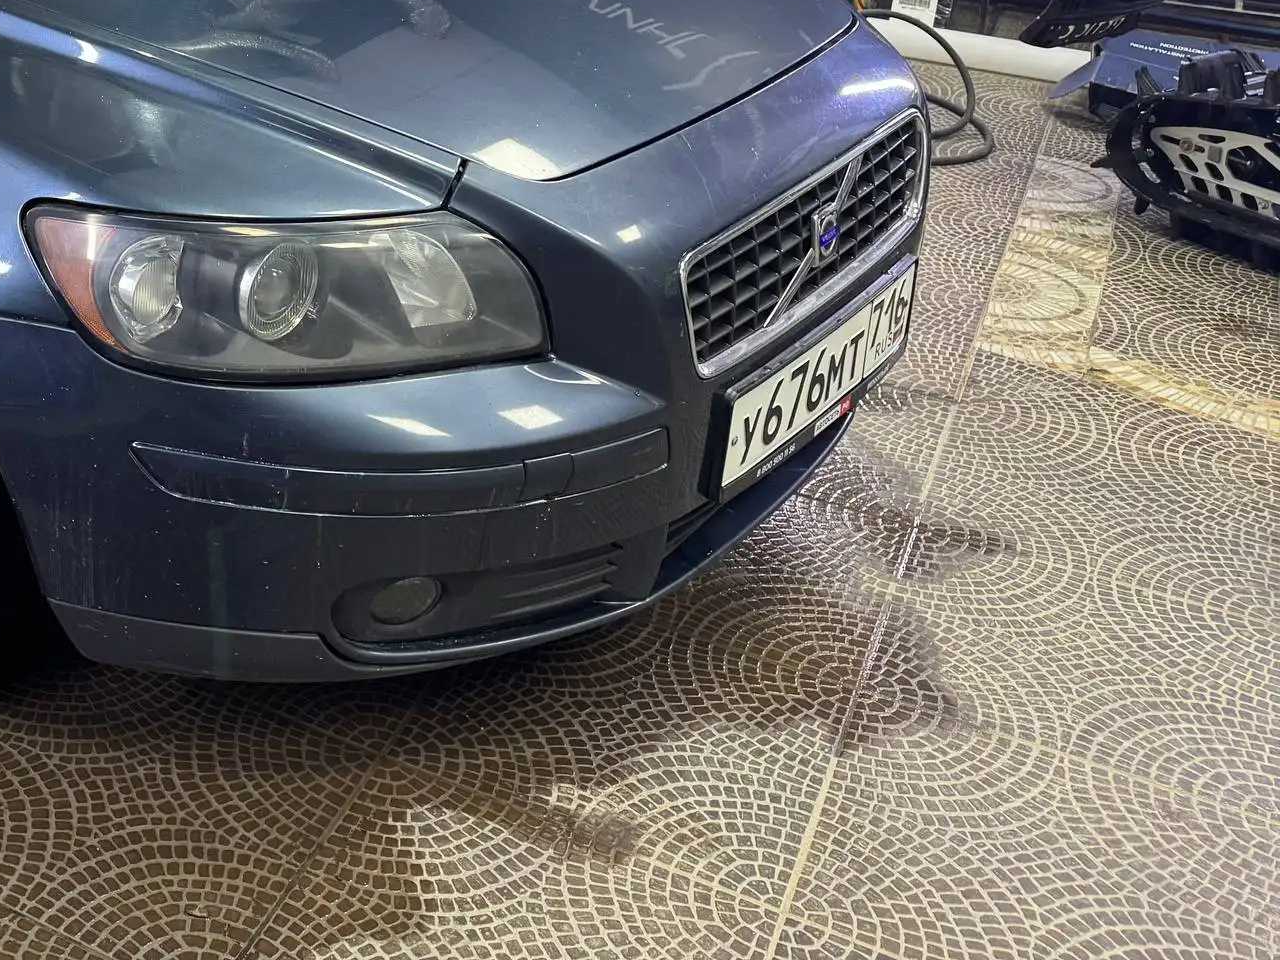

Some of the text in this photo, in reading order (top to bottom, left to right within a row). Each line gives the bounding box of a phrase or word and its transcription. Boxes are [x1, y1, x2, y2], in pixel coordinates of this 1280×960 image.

[1130, 42, 1186, 58] INSTALLATION
[874, 331, 893, 360] RUS
[739, 278, 908, 466] У676МТ 716
